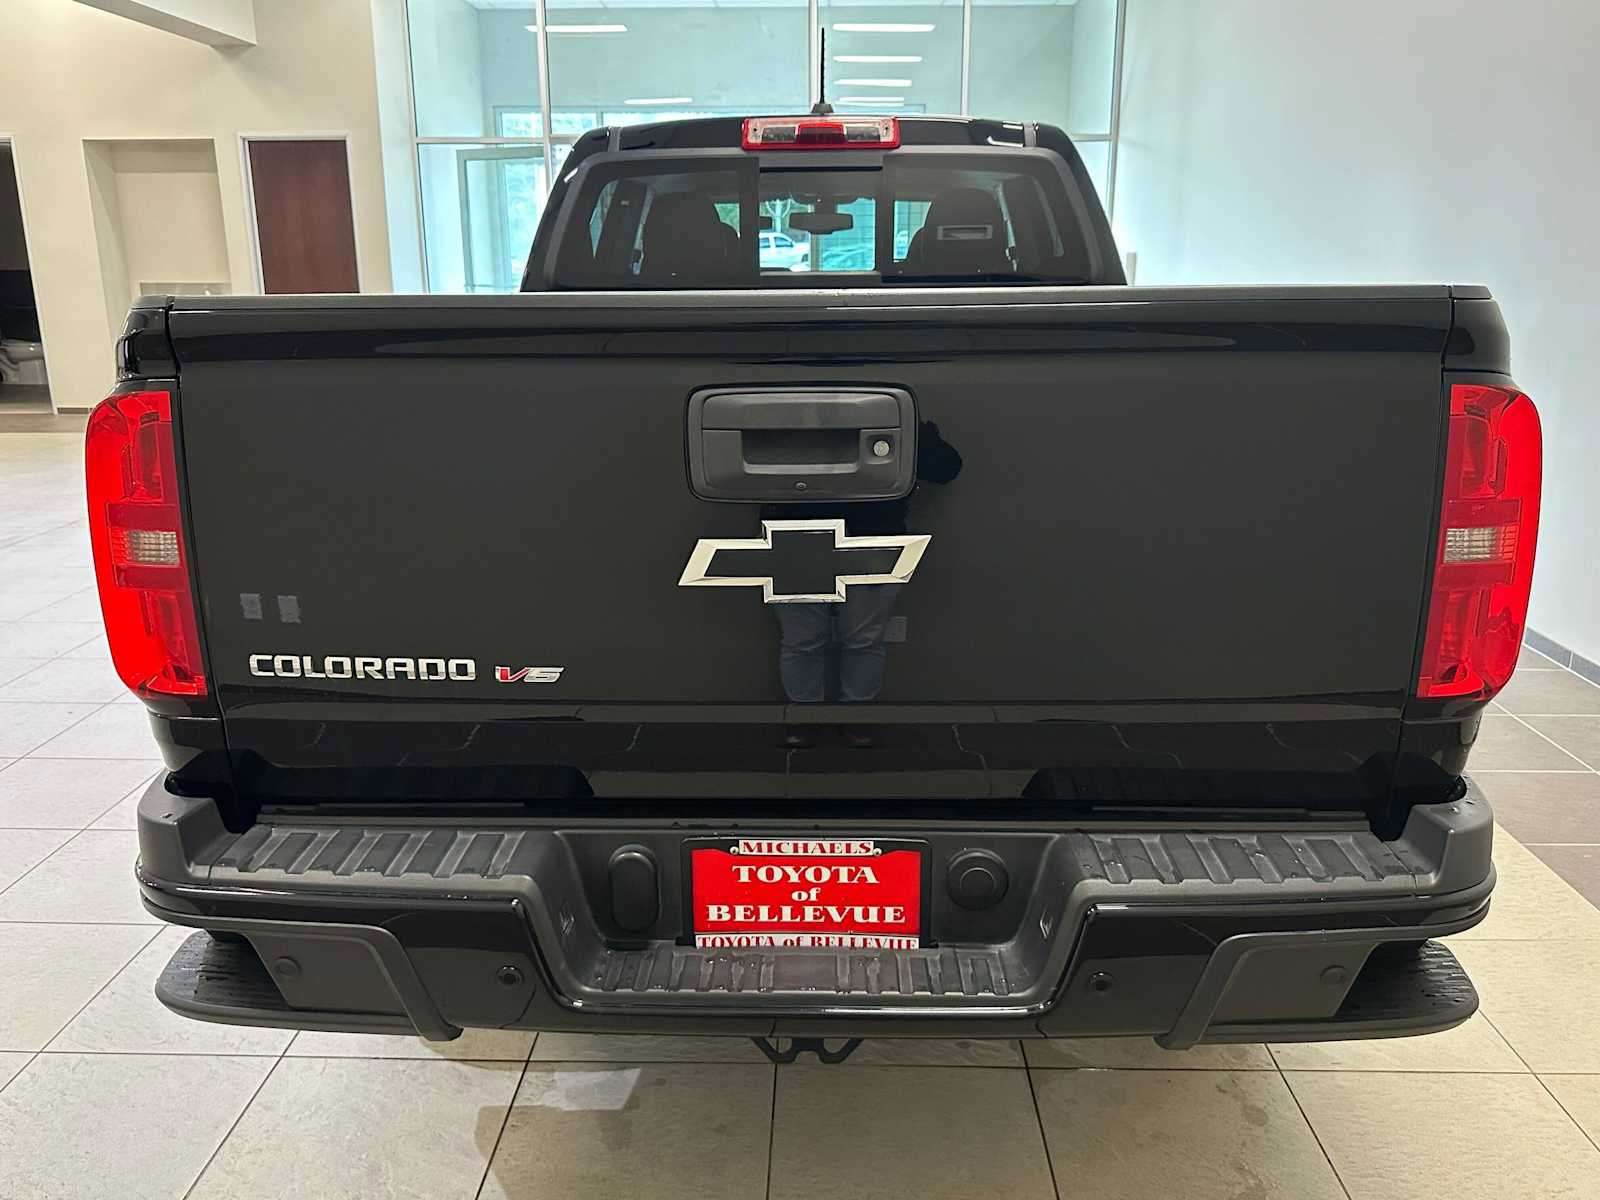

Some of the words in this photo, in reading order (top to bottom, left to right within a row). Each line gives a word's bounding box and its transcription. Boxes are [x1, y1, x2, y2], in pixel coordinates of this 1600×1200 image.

[249, 654, 476, 681] COLORADO
[495, 666, 564, 683] V6
[742, 841, 872, 854] MICHAELS
[732, 865, 880, 884] TOYOTA
[791, 887, 821, 902] of
[706, 905, 904, 923] BELLEVUE
[697, 937, 774, 948] TOYOTA
[783, 938, 804, 948] of
[811, 938, 917, 949] BELLEVUE
